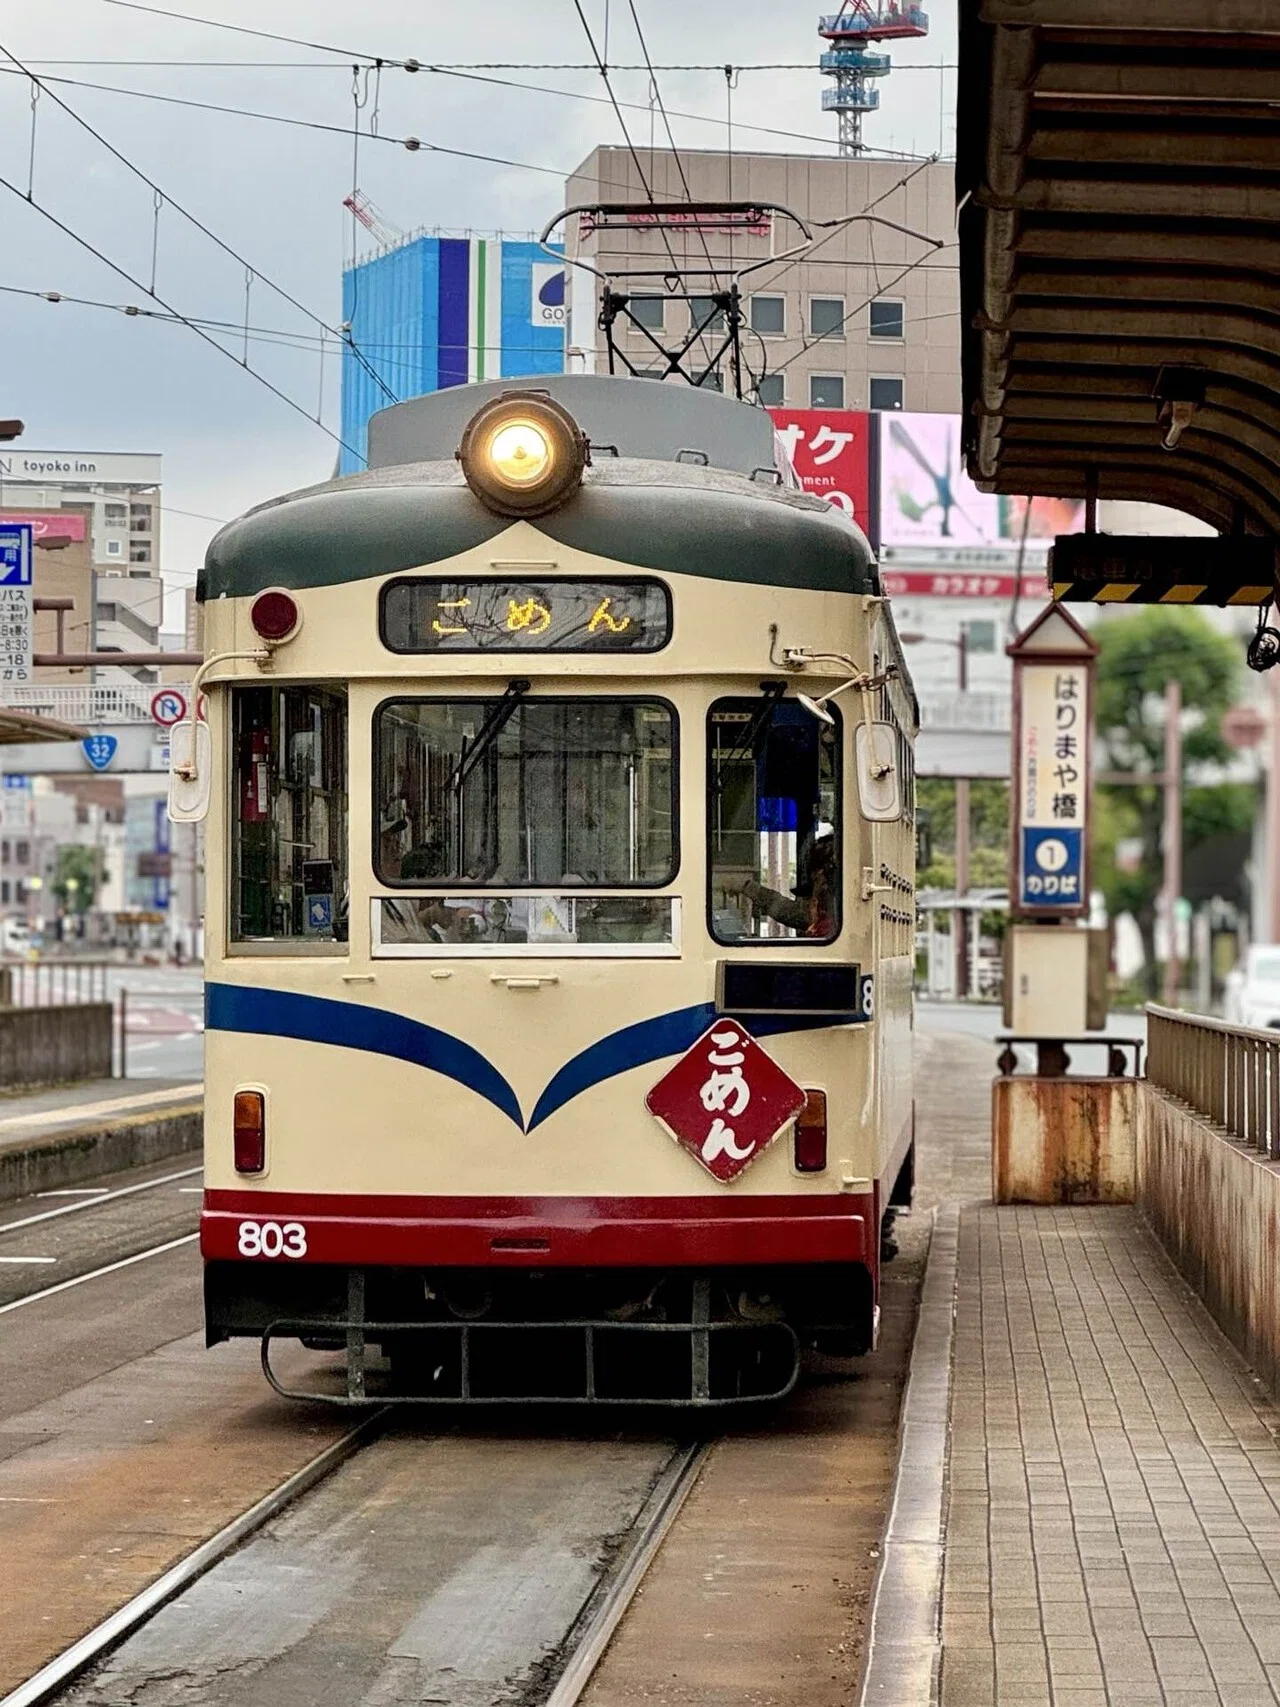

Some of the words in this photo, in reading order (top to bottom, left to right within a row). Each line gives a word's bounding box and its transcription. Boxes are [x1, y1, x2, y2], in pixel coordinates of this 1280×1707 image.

[23, 460, 71, 474] toyoko
[75, 460, 97, 473] inn
[432, 597, 631, 635] ごめん
[91, 743, 110, 758] 32
[1053, 674, 1079, 819] はりまや橋
[1026, 875, 1078, 896] のりば
[699, 1031, 756, 1162] ごめん
[238, 1221, 308, 1258] 803
